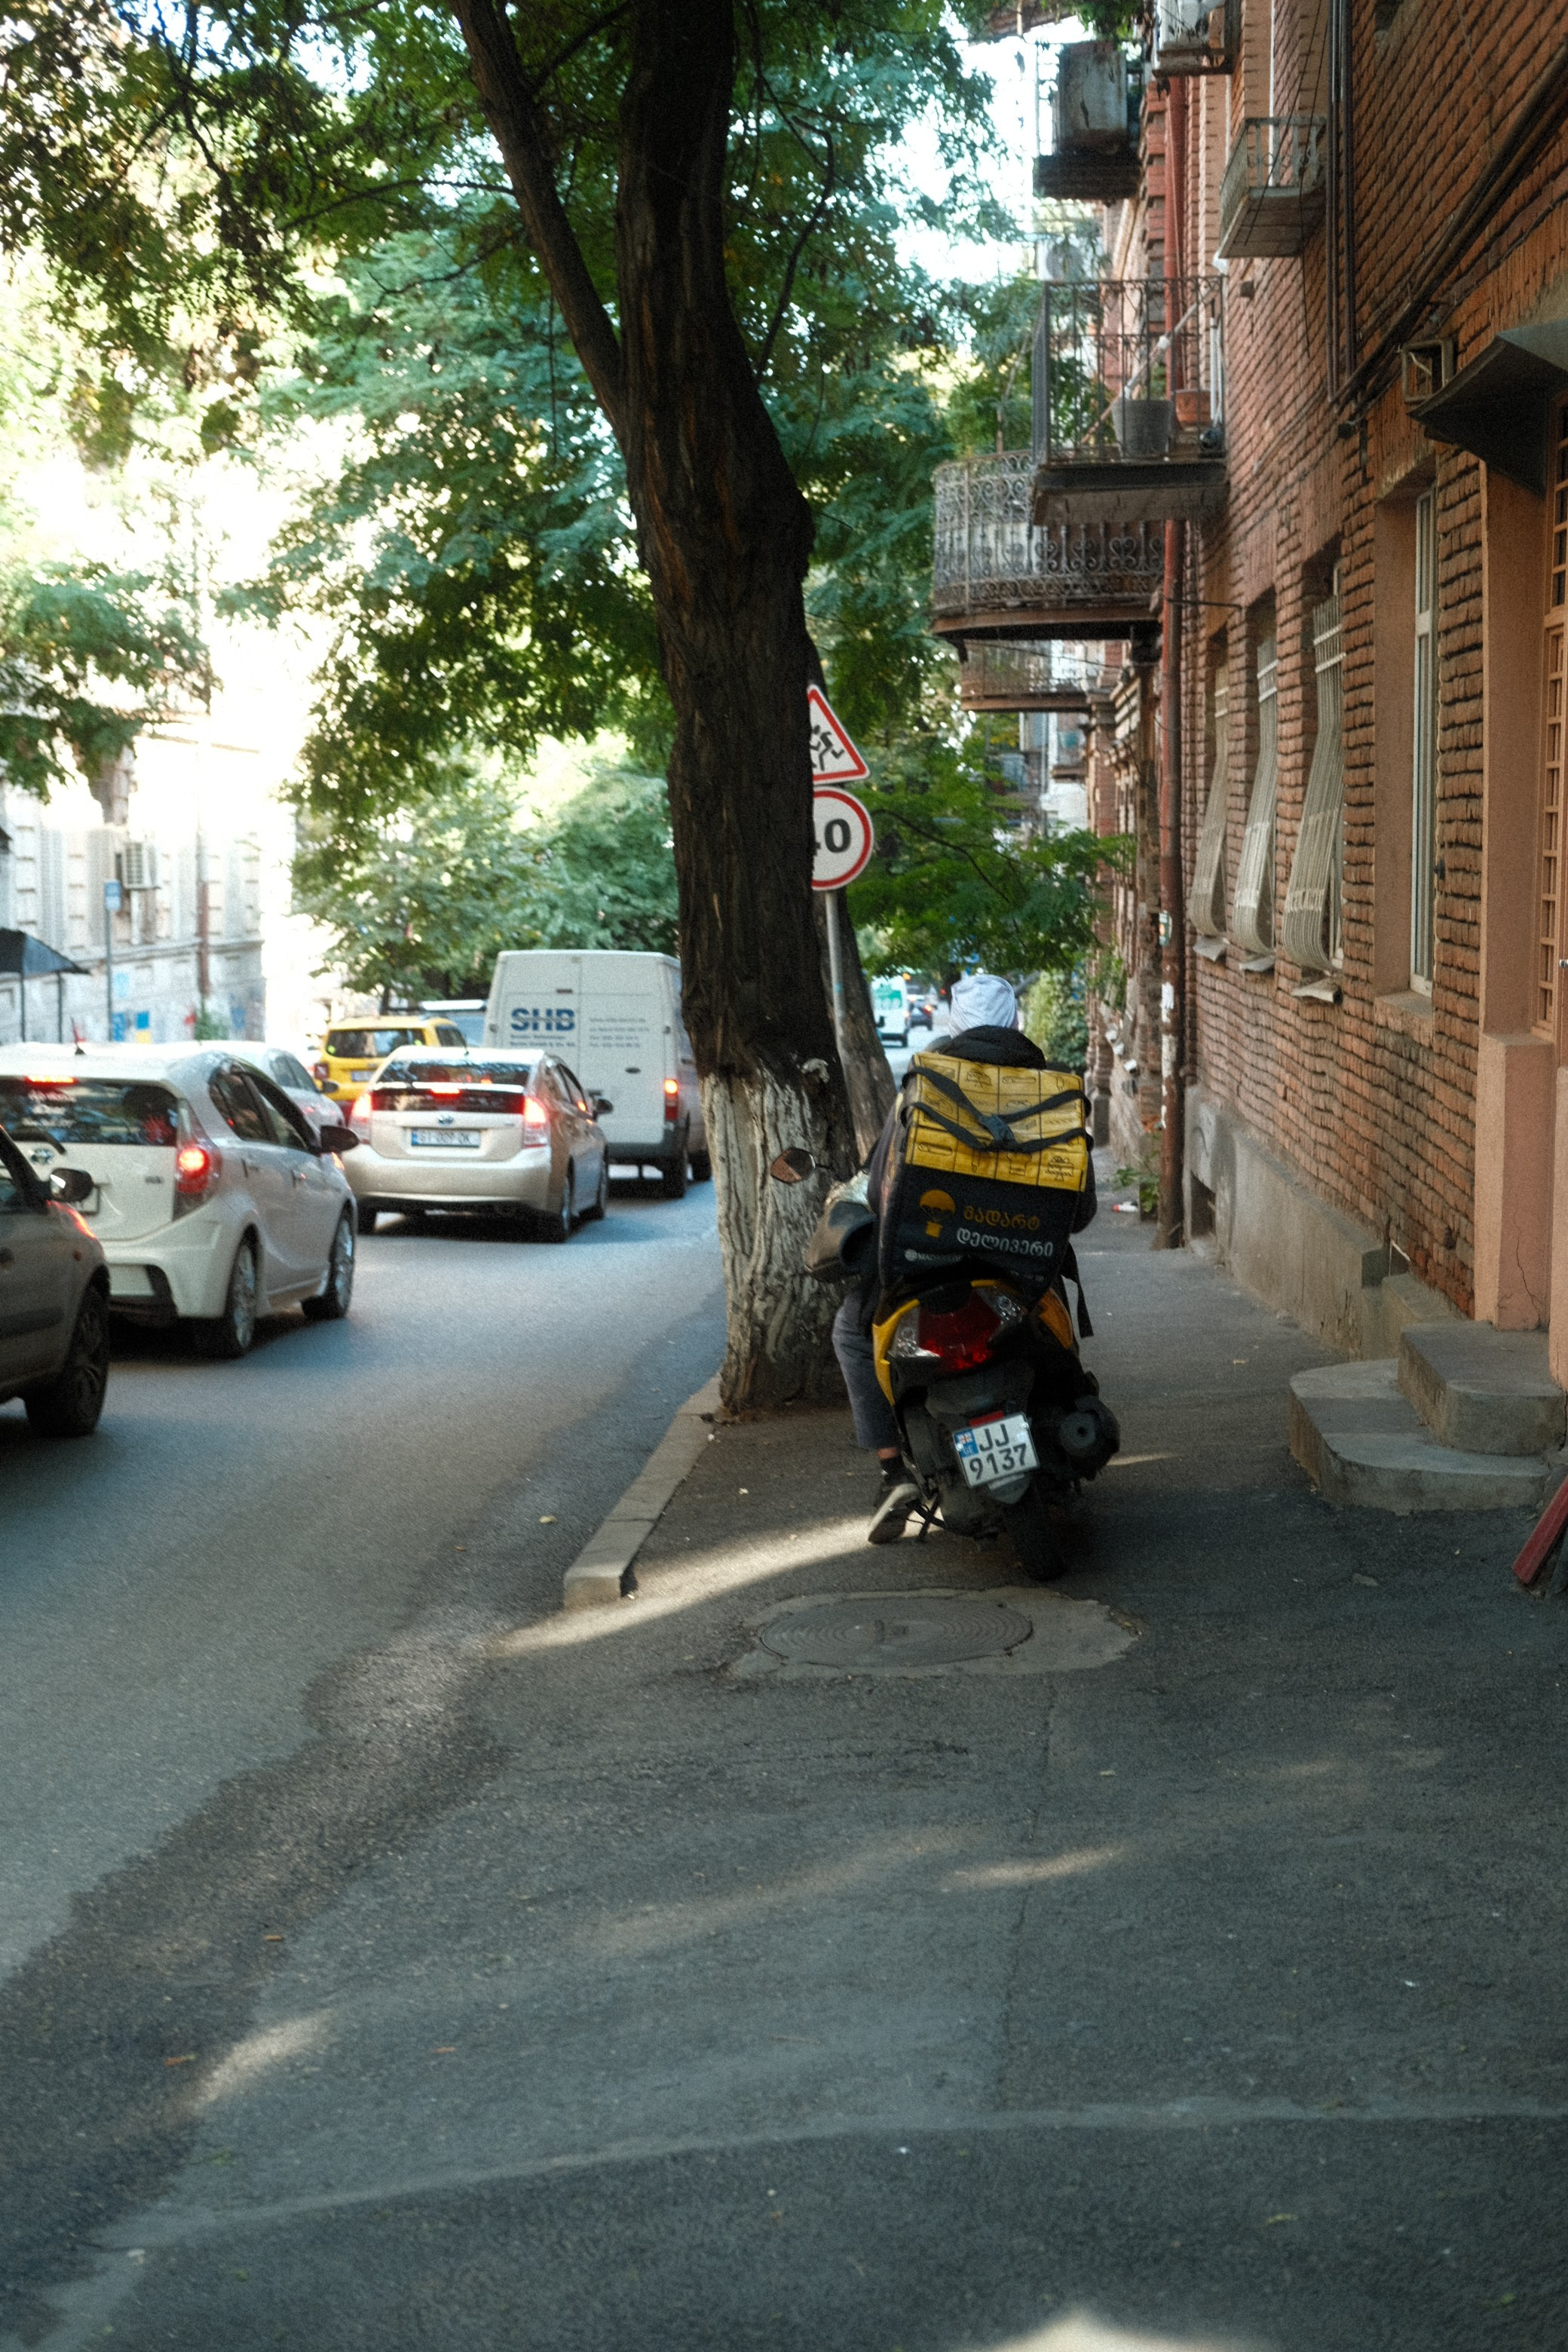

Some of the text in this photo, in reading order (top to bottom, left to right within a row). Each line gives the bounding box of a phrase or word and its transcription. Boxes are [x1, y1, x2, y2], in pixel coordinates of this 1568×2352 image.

[814, 818, 852, 853] 0
[511, 1008, 575, 1031] SHB
[964, 1205, 1040, 1230] მადარტ
[957, 1227, 1053, 1257] დელივერი
[979, 1423, 1009, 1452] JJ
[969, 1443, 1027, 1481] 9137
